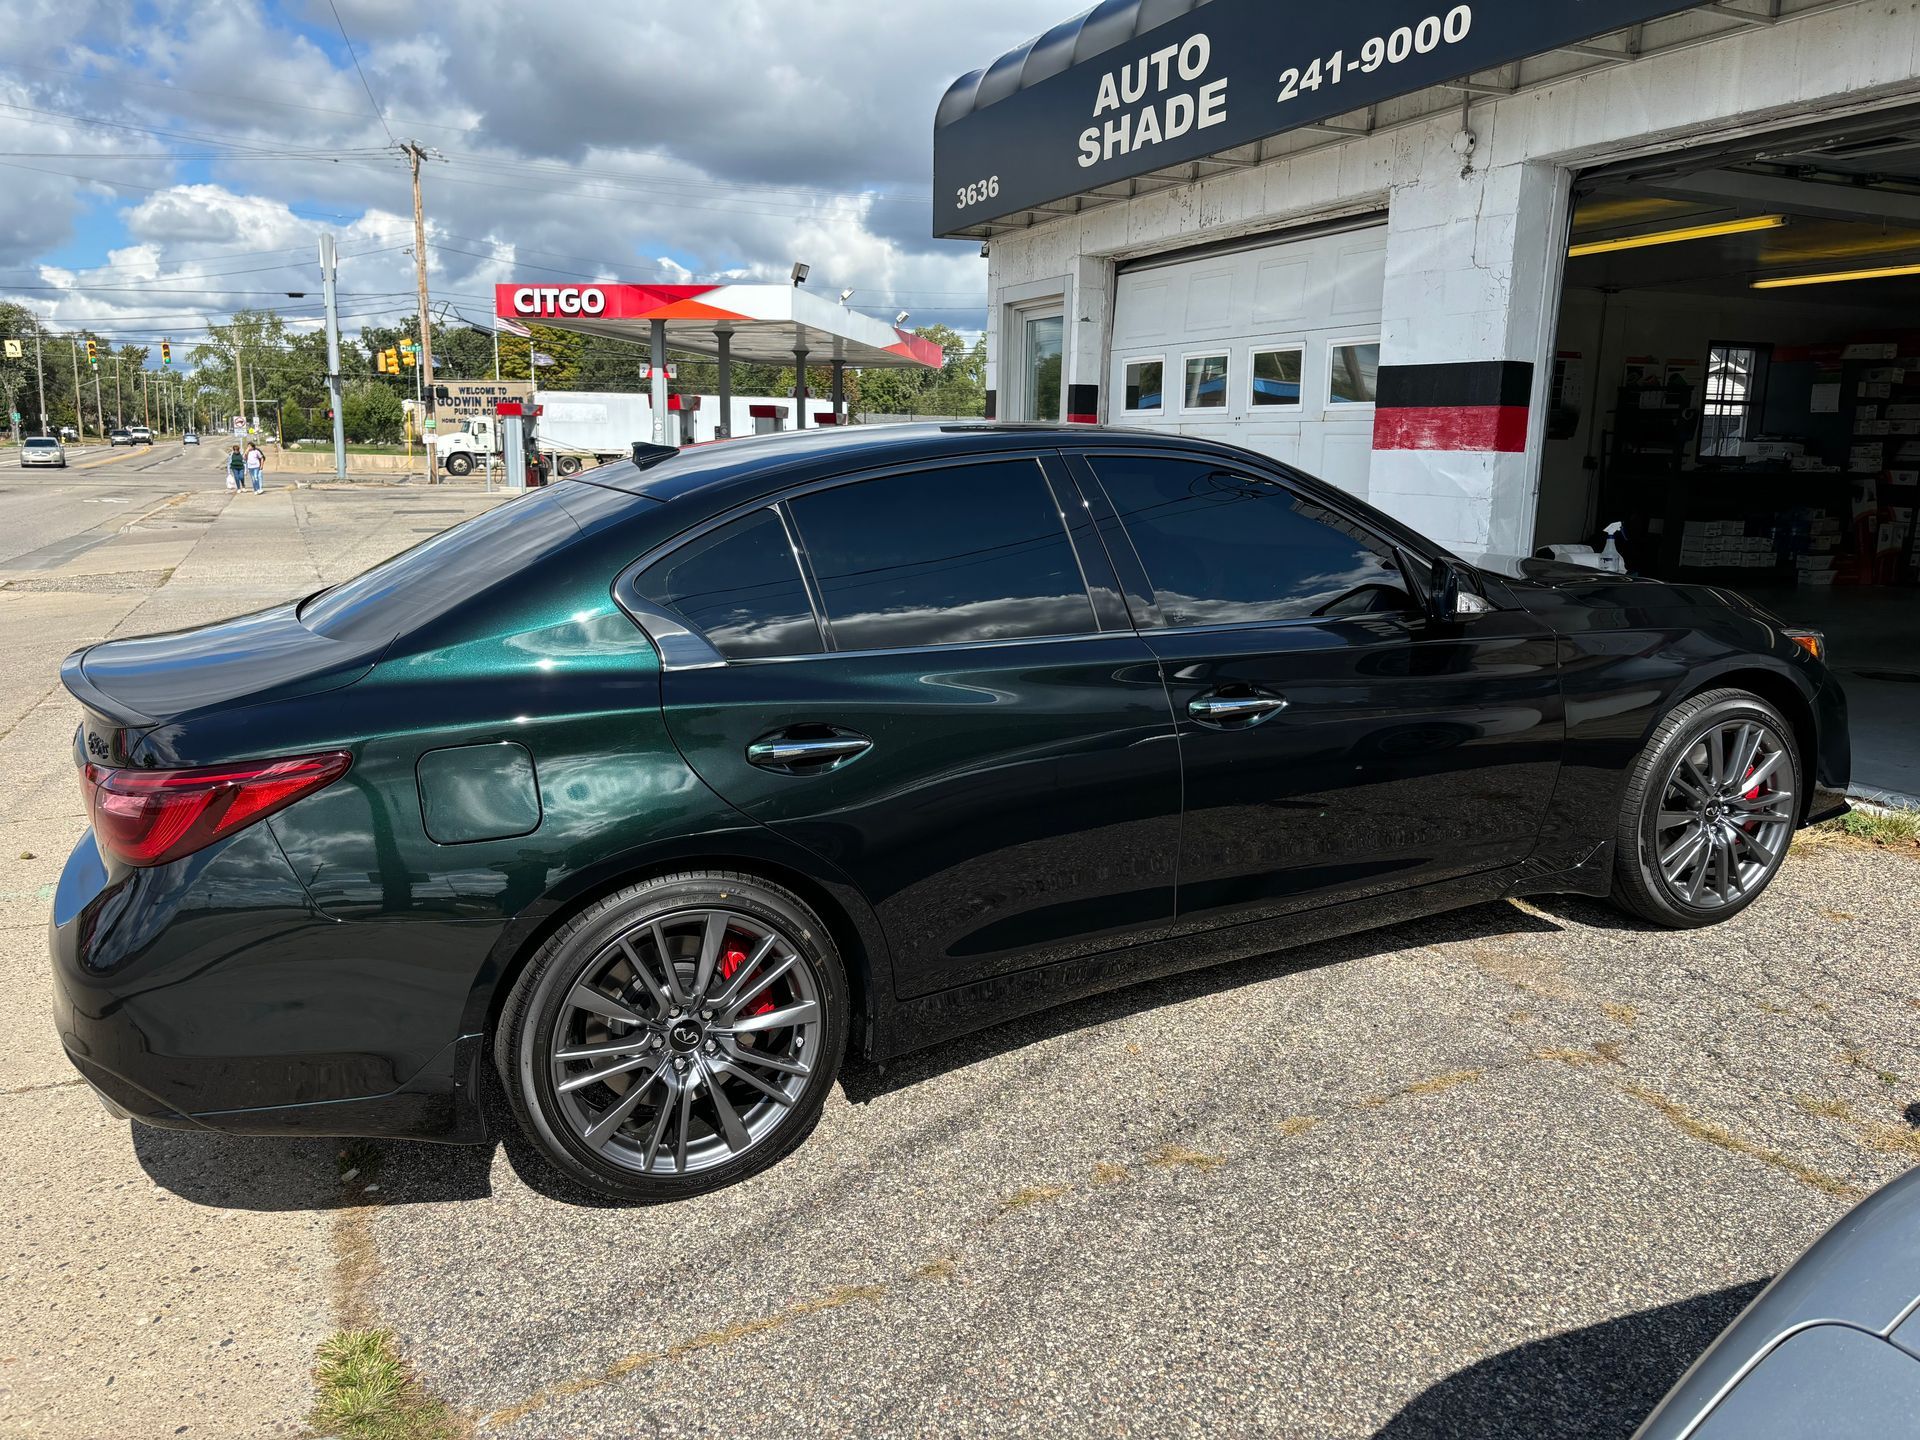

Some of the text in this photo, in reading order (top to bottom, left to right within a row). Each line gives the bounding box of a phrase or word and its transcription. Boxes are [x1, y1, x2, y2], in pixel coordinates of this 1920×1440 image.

[1277, 4, 1472, 103] 241-9000
[1093, 33, 1210, 117] AUTO
[1078, 77, 1228, 168] SHADE
[956, 175, 999, 209] 3636
[513, 287, 605, 316] CITGO
[437, 396, 482, 407] GODWIN
[458, 387, 507, 395] WELCOME TO
[454, 408, 479, 416] PUBLIC
